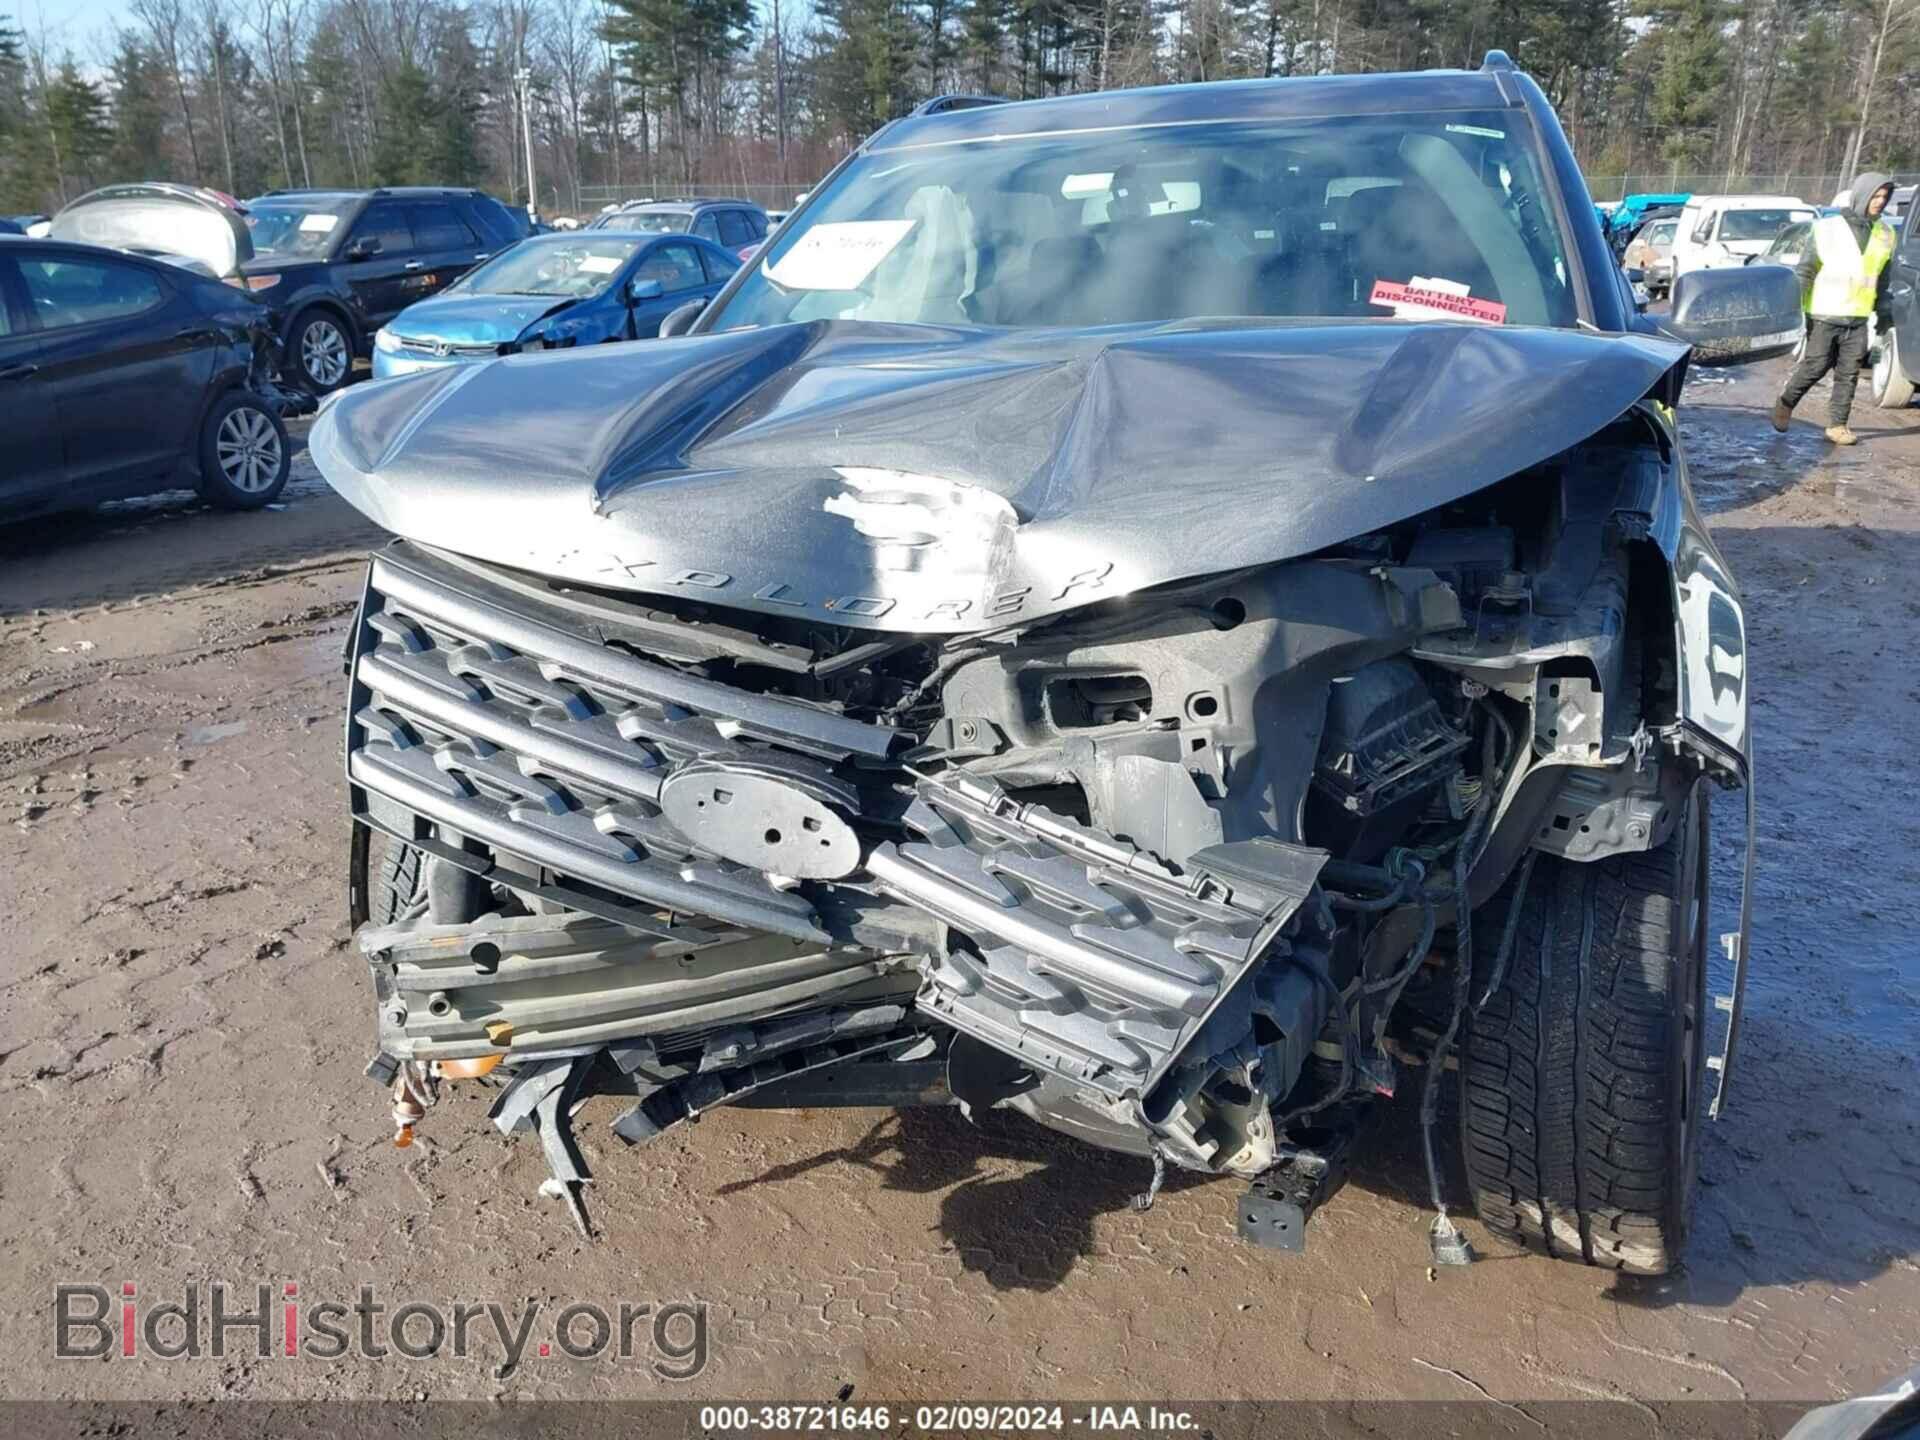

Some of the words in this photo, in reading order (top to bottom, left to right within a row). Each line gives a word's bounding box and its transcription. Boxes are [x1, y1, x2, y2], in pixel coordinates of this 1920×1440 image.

[1375, 290, 1500, 322] DISCONNECTED
[1404, 287, 1476, 306] BATTERY
[528, 549, 1114, 621] XPLORER
